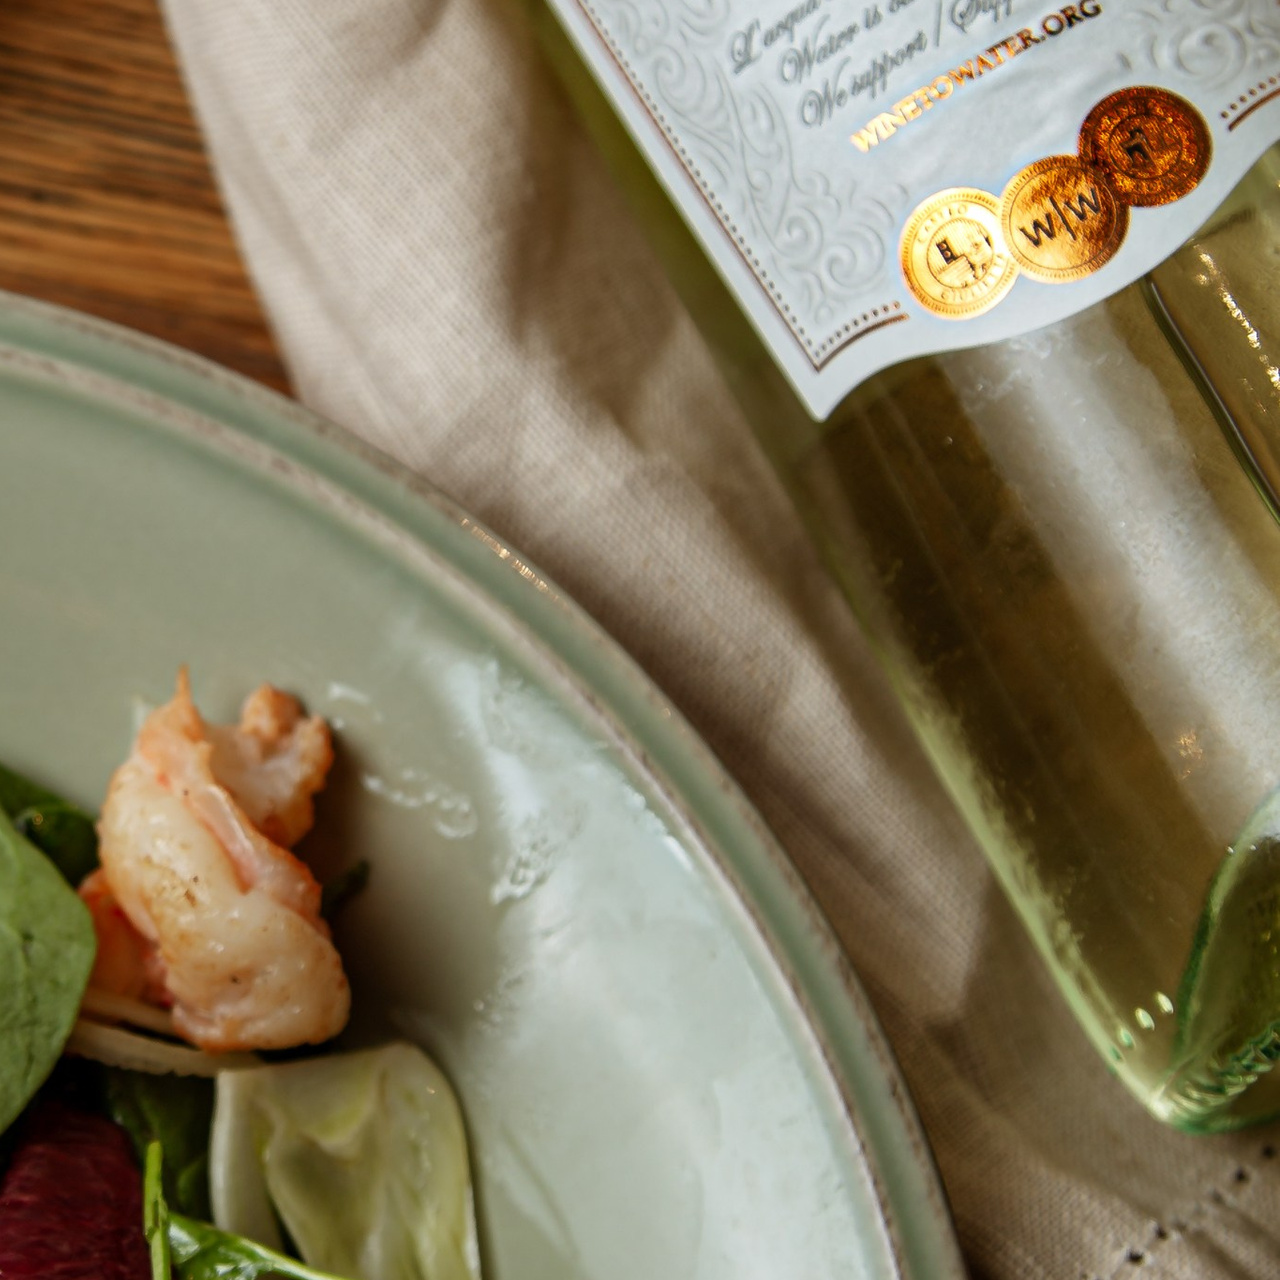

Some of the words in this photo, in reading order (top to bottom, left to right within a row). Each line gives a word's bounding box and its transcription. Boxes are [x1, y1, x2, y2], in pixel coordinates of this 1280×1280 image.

[781, 13, 859, 84] Water
[864, 4, 883, 30] is
[800, 55, 852, 127] We
[851, 28, 927, 100] support
